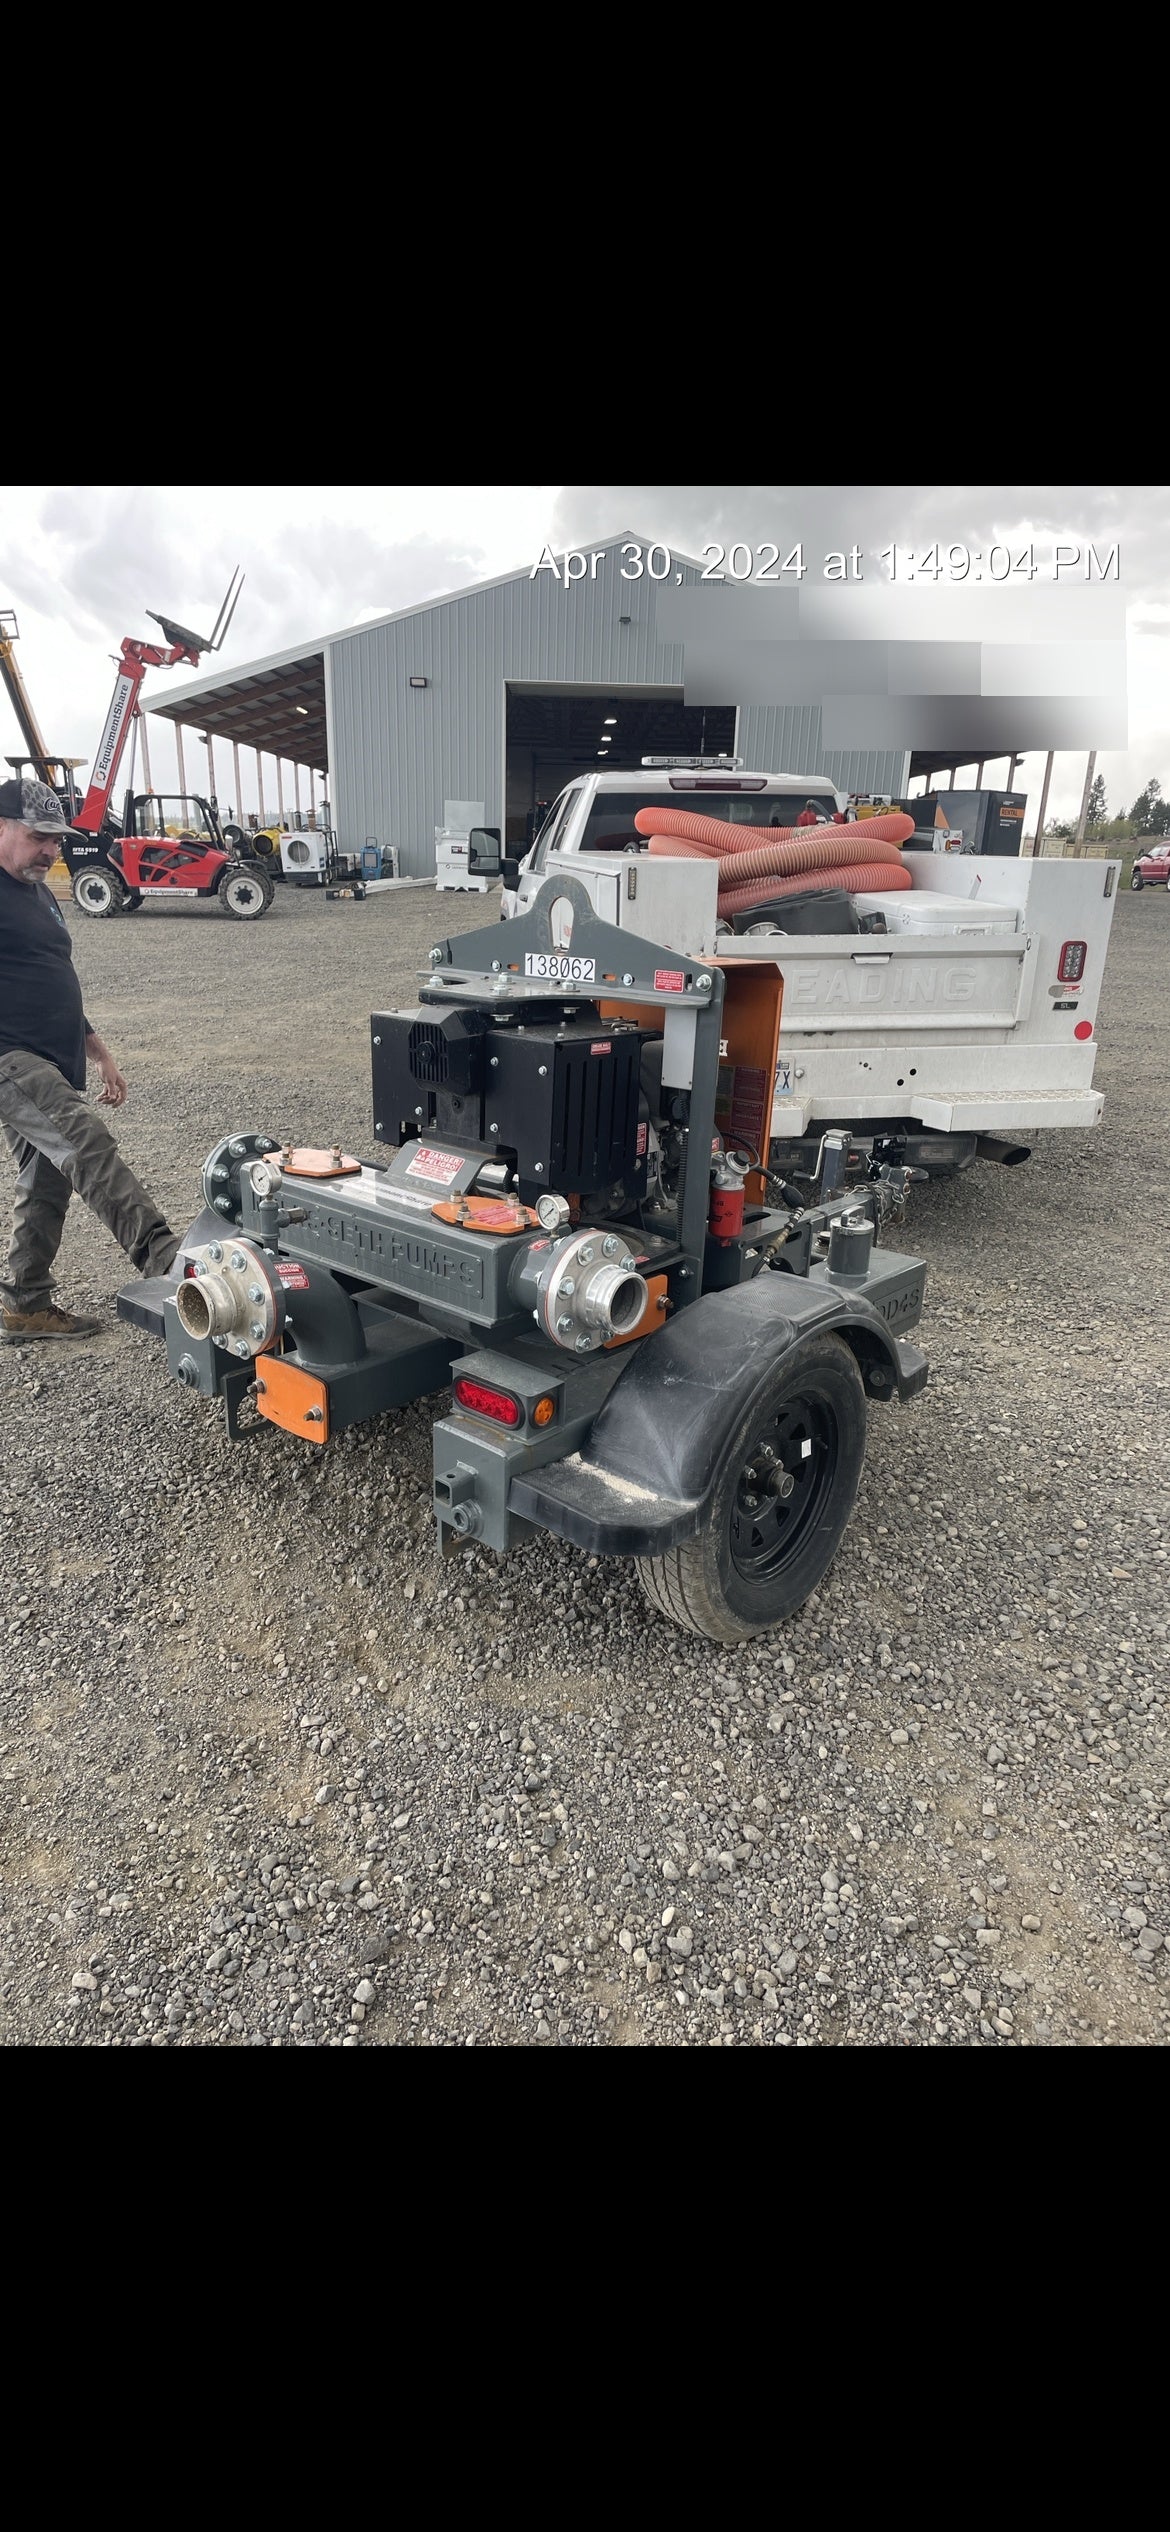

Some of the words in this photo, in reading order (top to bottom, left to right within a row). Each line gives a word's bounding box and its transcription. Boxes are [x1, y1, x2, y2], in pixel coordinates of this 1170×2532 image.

[99, 684, 128, 770] EquipmentShare
[527, 954, 594, 980] 138062
[791, 967, 977, 1004] EADING
[391, 1233, 475, 1288] PUMPS
